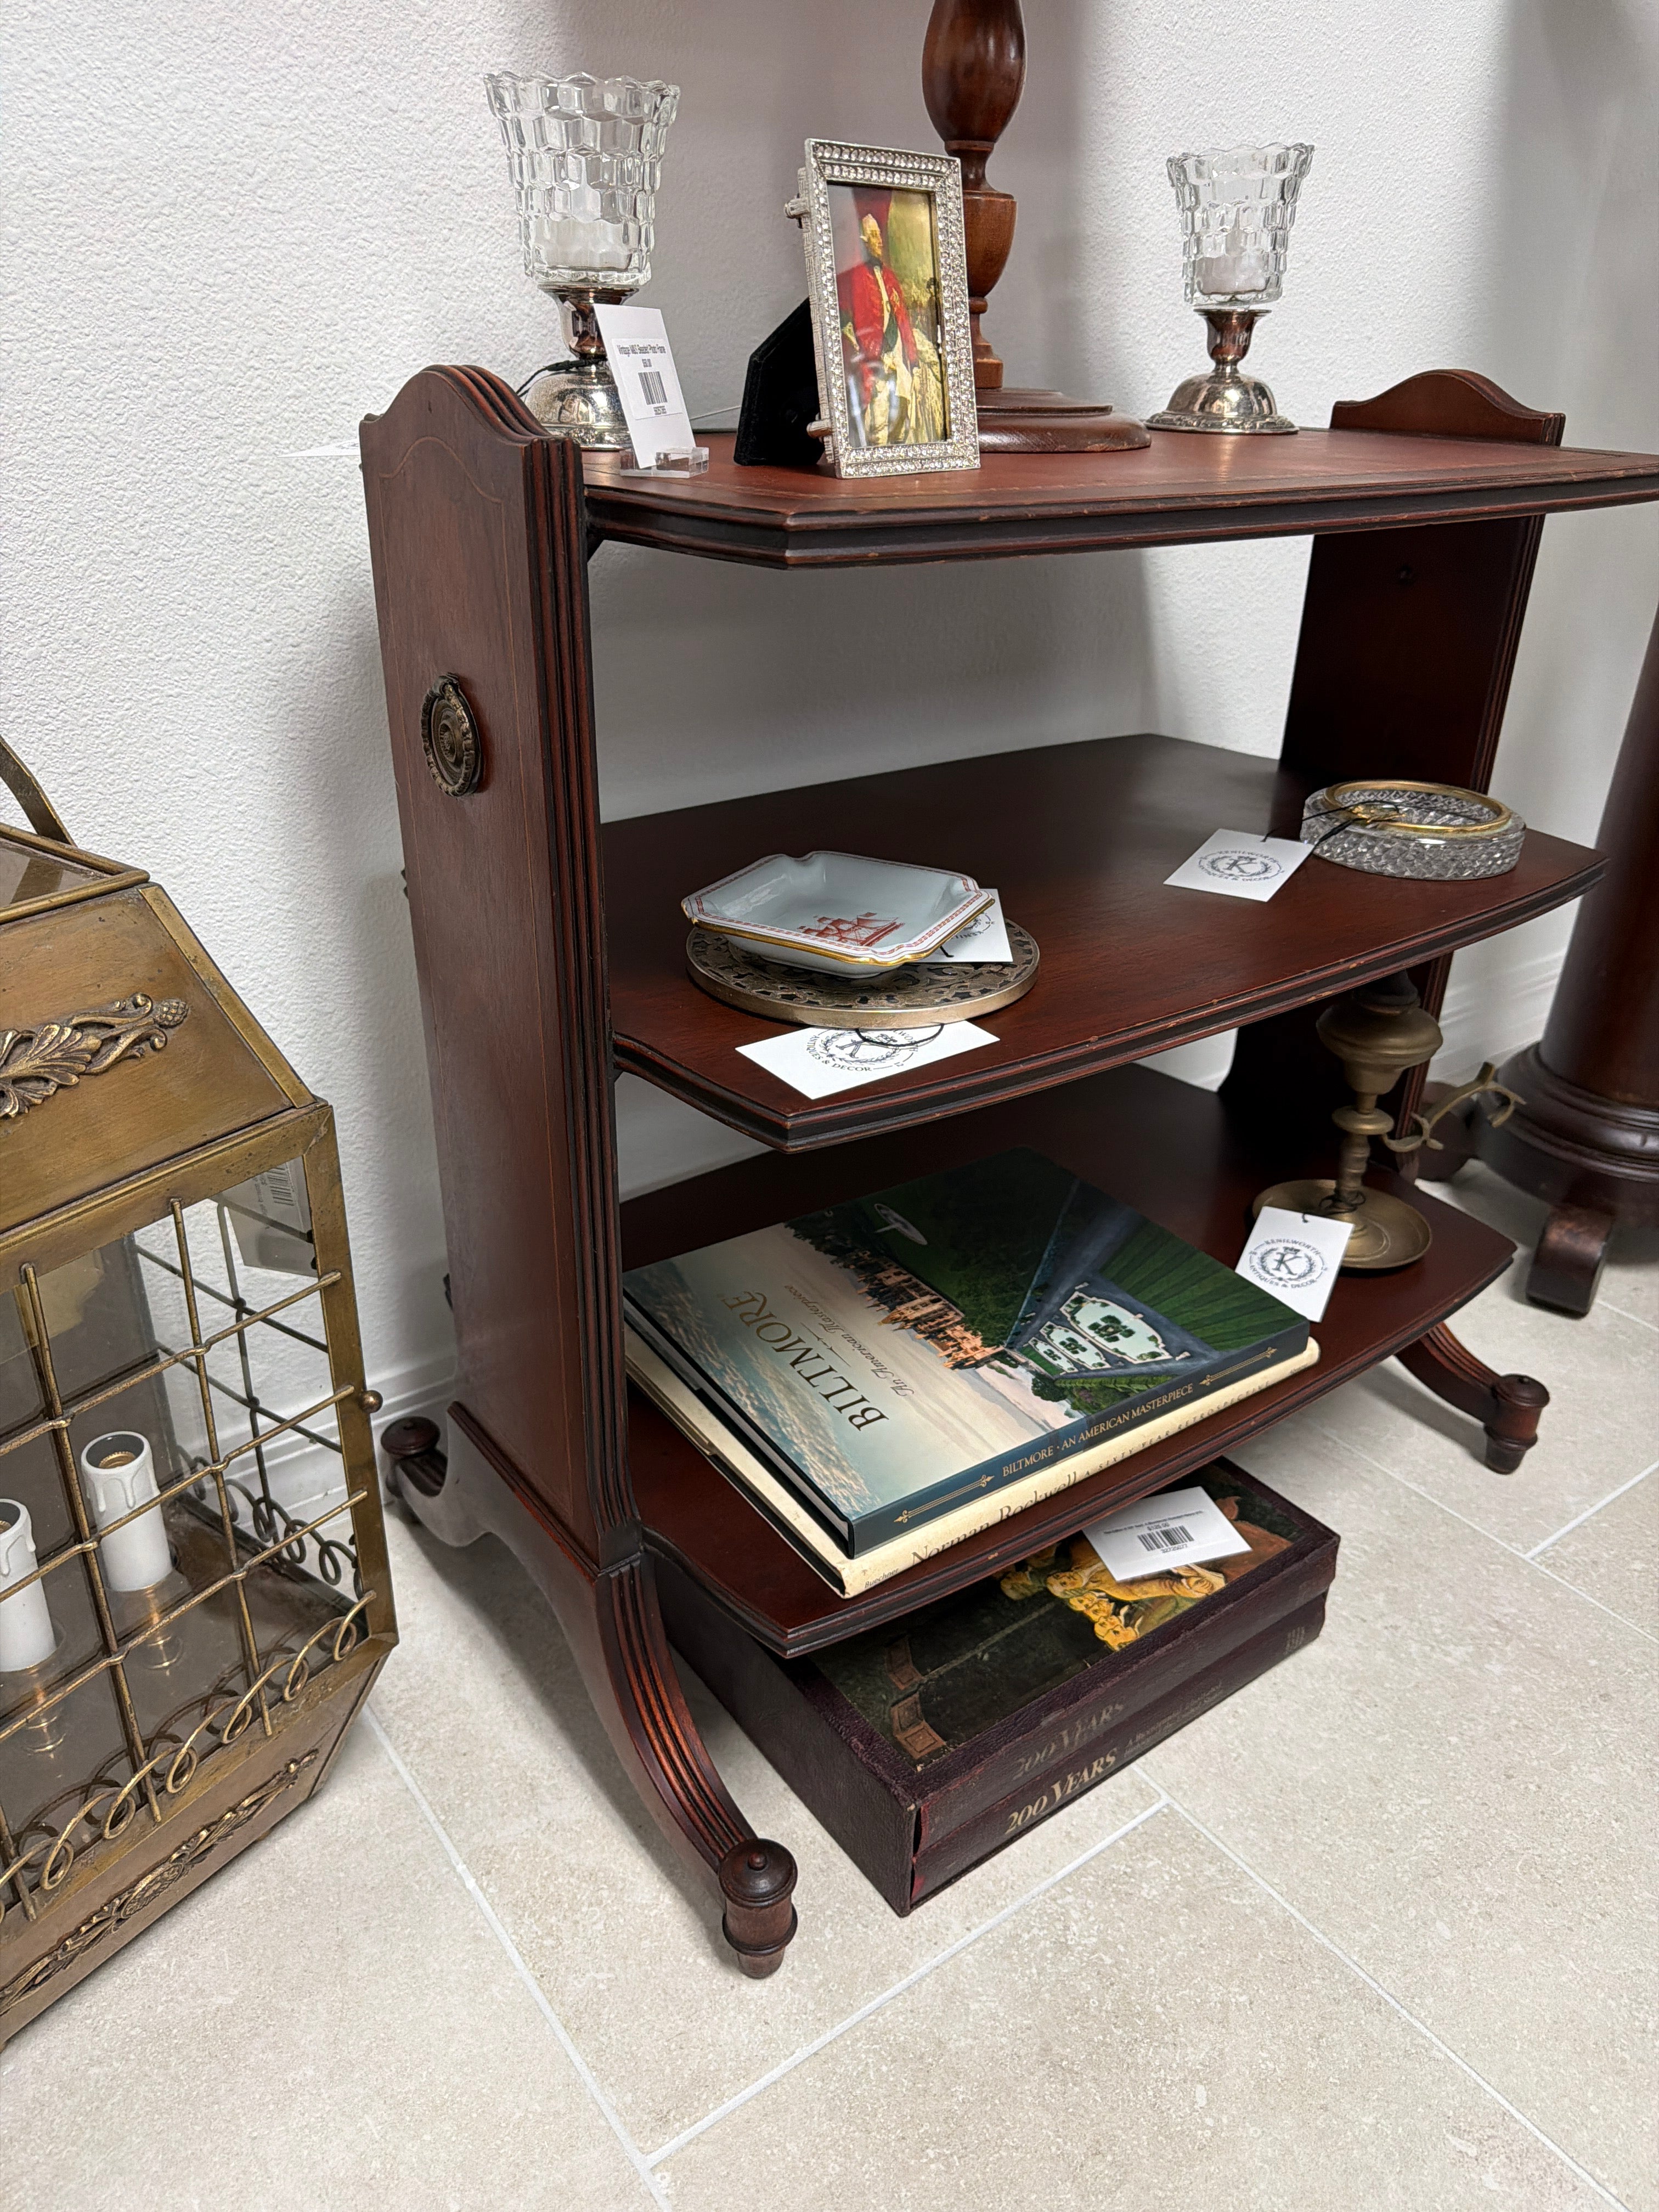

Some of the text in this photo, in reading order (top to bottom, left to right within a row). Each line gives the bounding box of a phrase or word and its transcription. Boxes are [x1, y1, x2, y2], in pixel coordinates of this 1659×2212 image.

[831, 1063, 872, 1071] DECOR
[1272, 1252, 1302, 1276] K
[721, 1290, 889, 1431] BILTMORE
[841, 1333, 895, 1379] American
[1002, 1383, 1193, 1477] BILTMORE AN AMERICAN MASTERPIECE
[865, 1567, 899, 1589] Buechner
[1005, 1747, 1118, 1835] 200 YEARS
